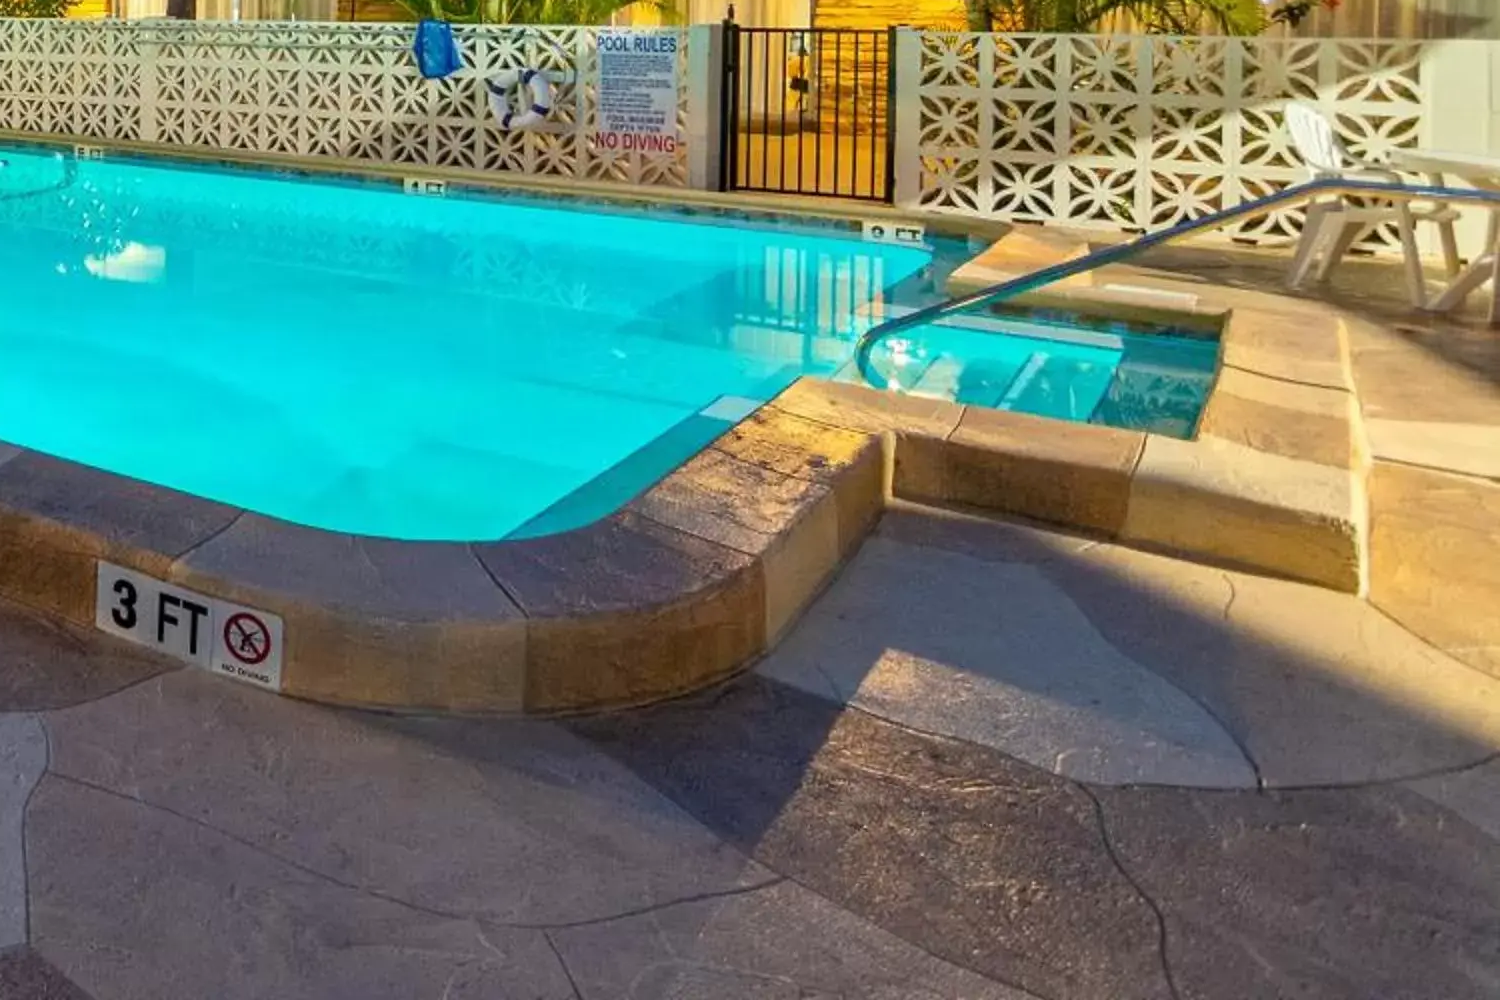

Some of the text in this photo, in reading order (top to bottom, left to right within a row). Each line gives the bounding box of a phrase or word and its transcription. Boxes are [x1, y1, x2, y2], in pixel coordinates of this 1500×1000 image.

[597, 35, 677, 53] POOL RULES
[595, 131, 675, 152] NO DIVING
[111, 579, 208, 655] 3 FT
